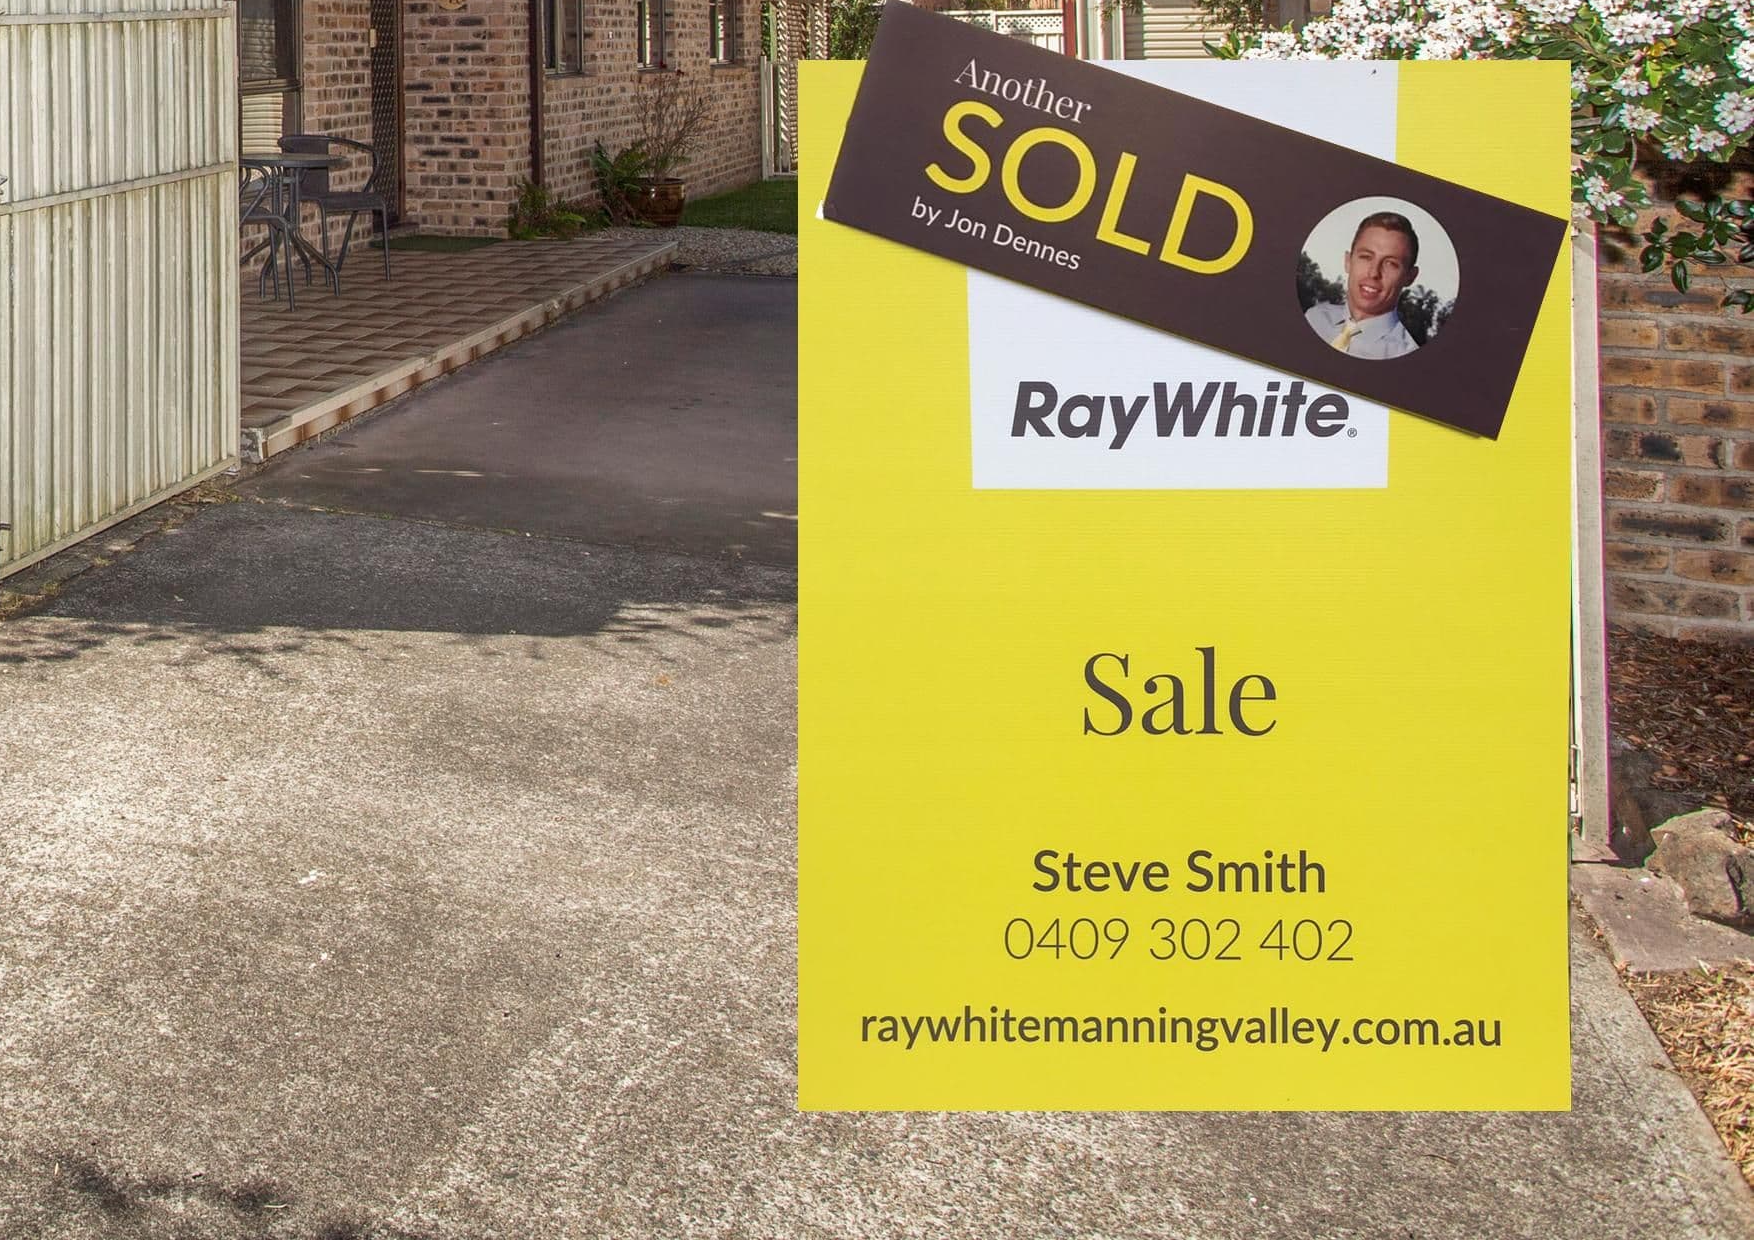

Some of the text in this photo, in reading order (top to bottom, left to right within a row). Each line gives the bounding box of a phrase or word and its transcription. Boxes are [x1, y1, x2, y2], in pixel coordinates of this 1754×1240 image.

[954, 58, 1091, 124] Another
[926, 100, 1254, 275] SOLD
[911, 195, 1081, 270] by Jon Dennes
[1083, 646, 1277, 736] Sale
[1032, 849, 1326, 893] Steve Smith
[1004, 917, 1354, 962] 0409 302 402
[860, 1005, 1502, 1053] raywhitemanningvalley.com.au
